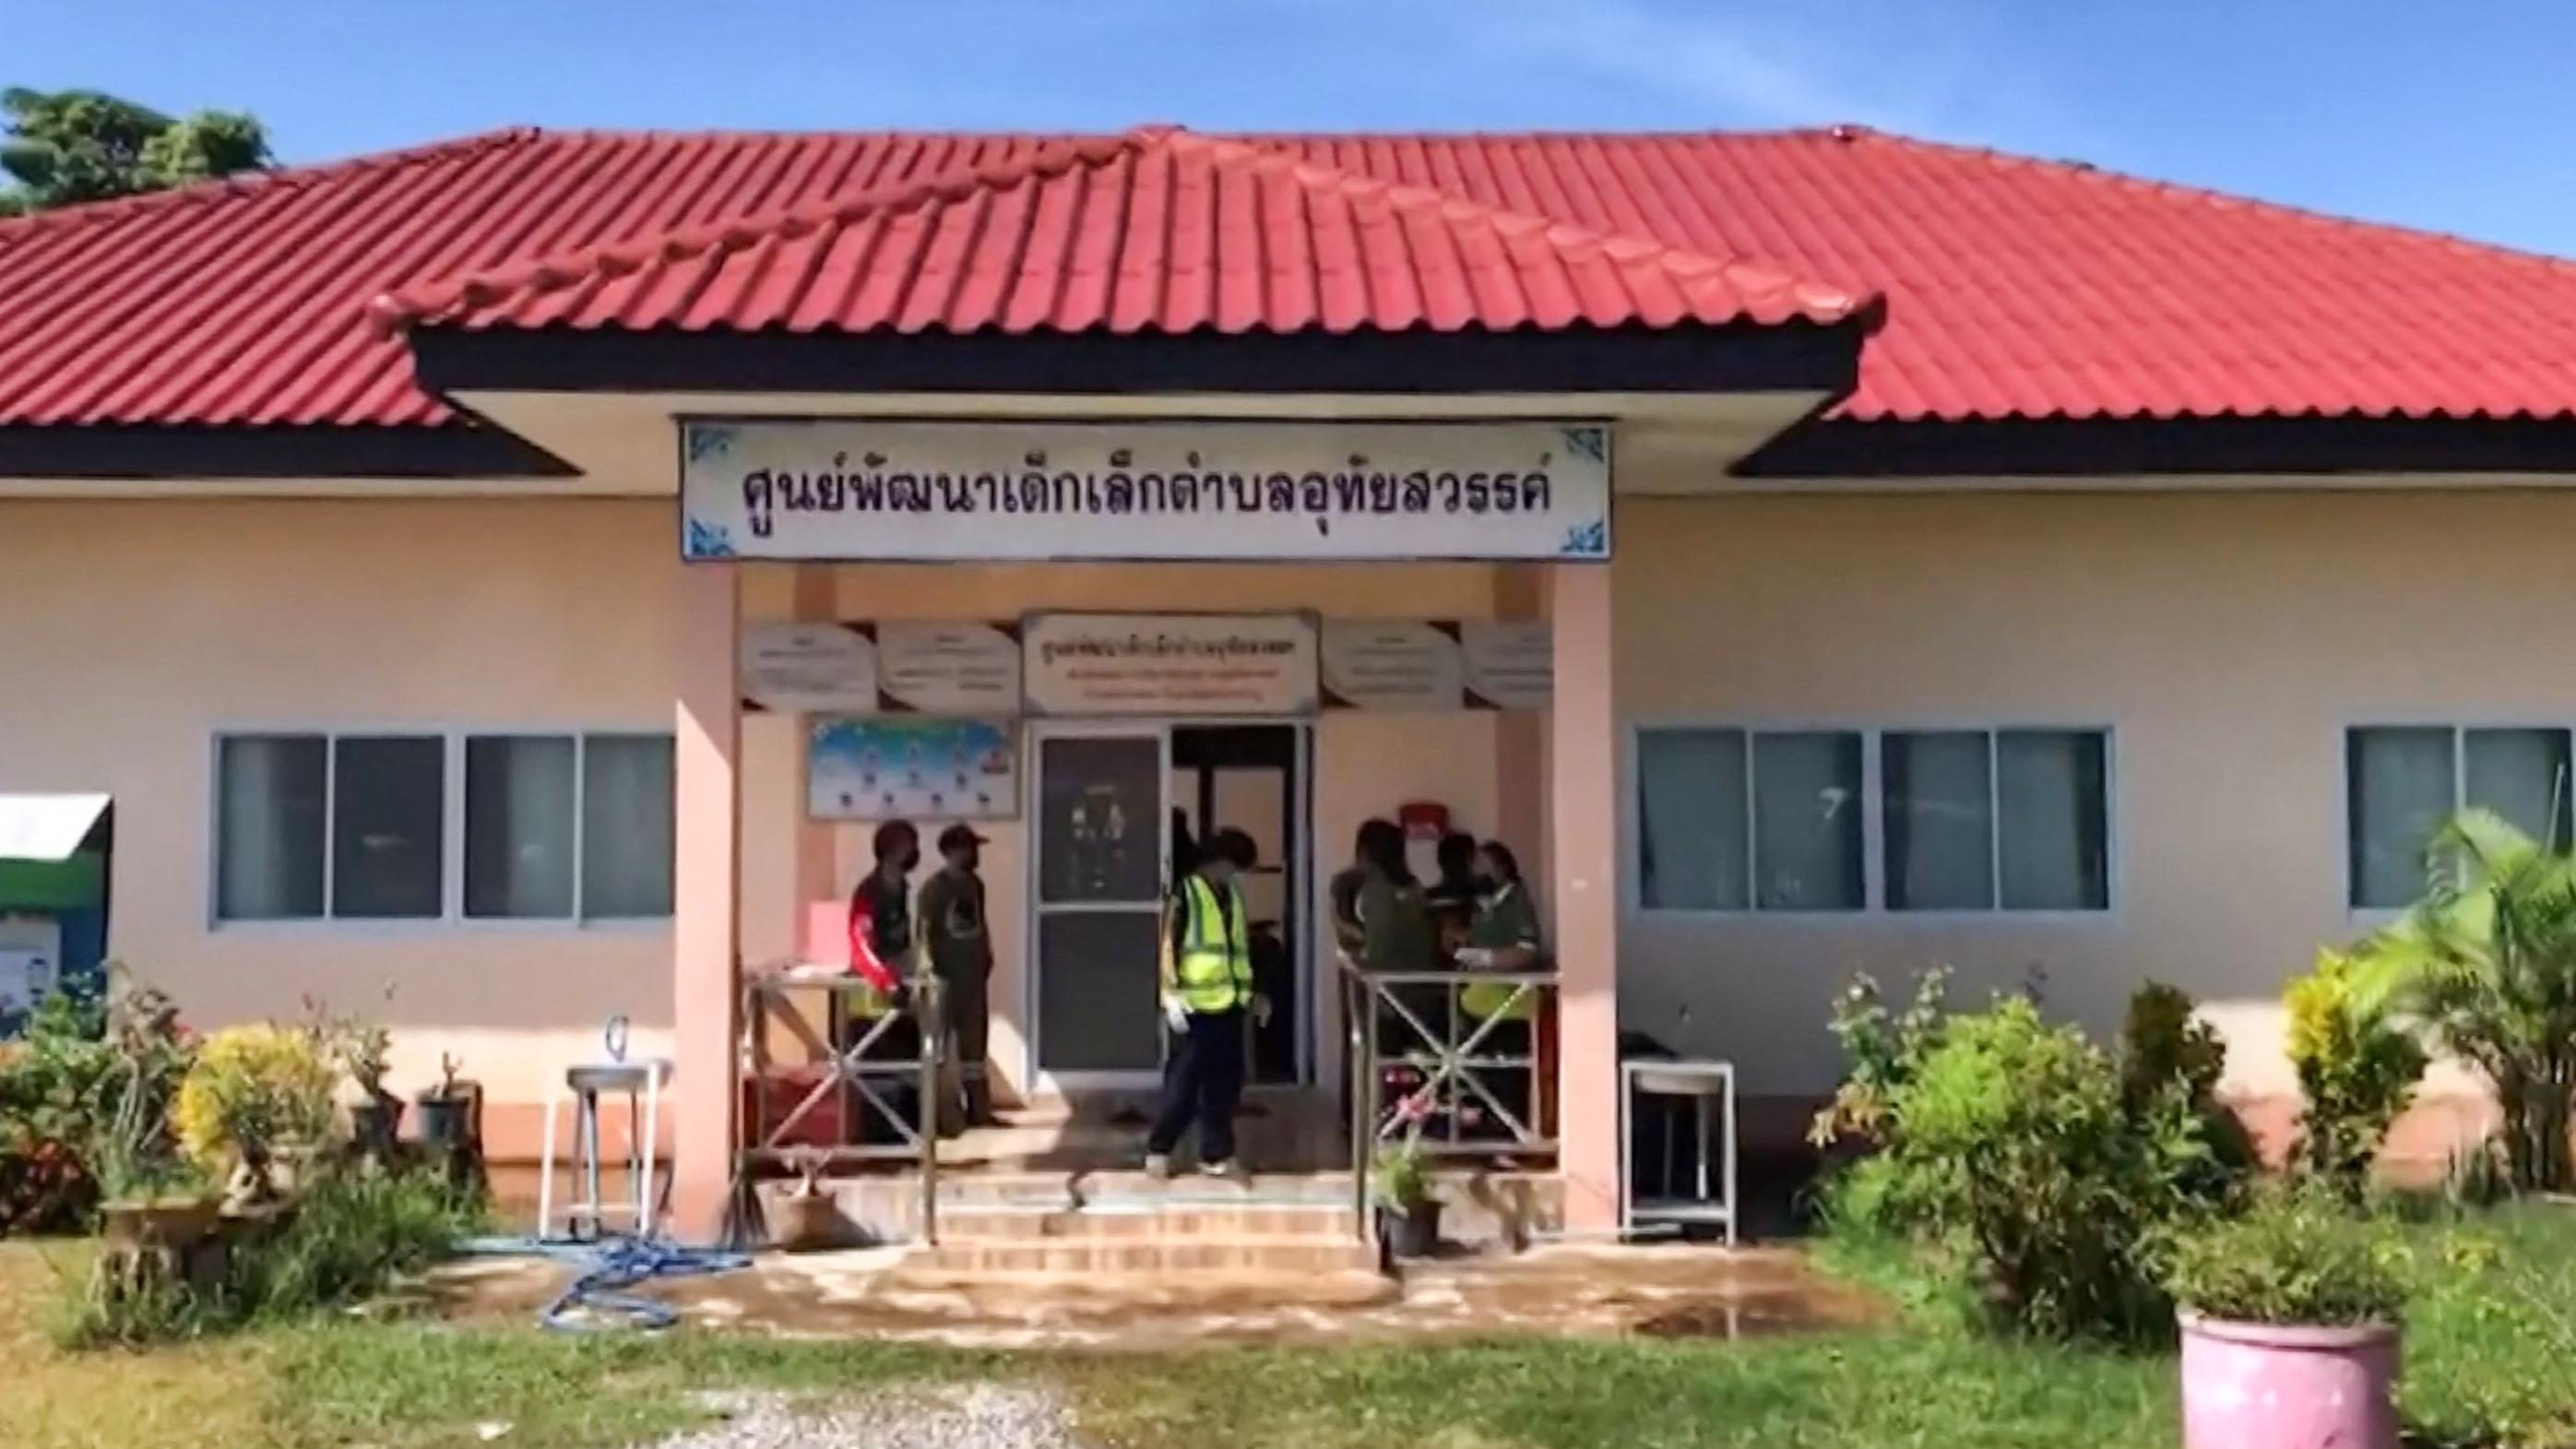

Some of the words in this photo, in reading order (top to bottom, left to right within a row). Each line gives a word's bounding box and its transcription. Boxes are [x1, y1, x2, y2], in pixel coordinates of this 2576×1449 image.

[742, 448, 1551, 537] ศูนย์พัฒนาเด็กเล็กตำบลอุทัยสวรรค์
